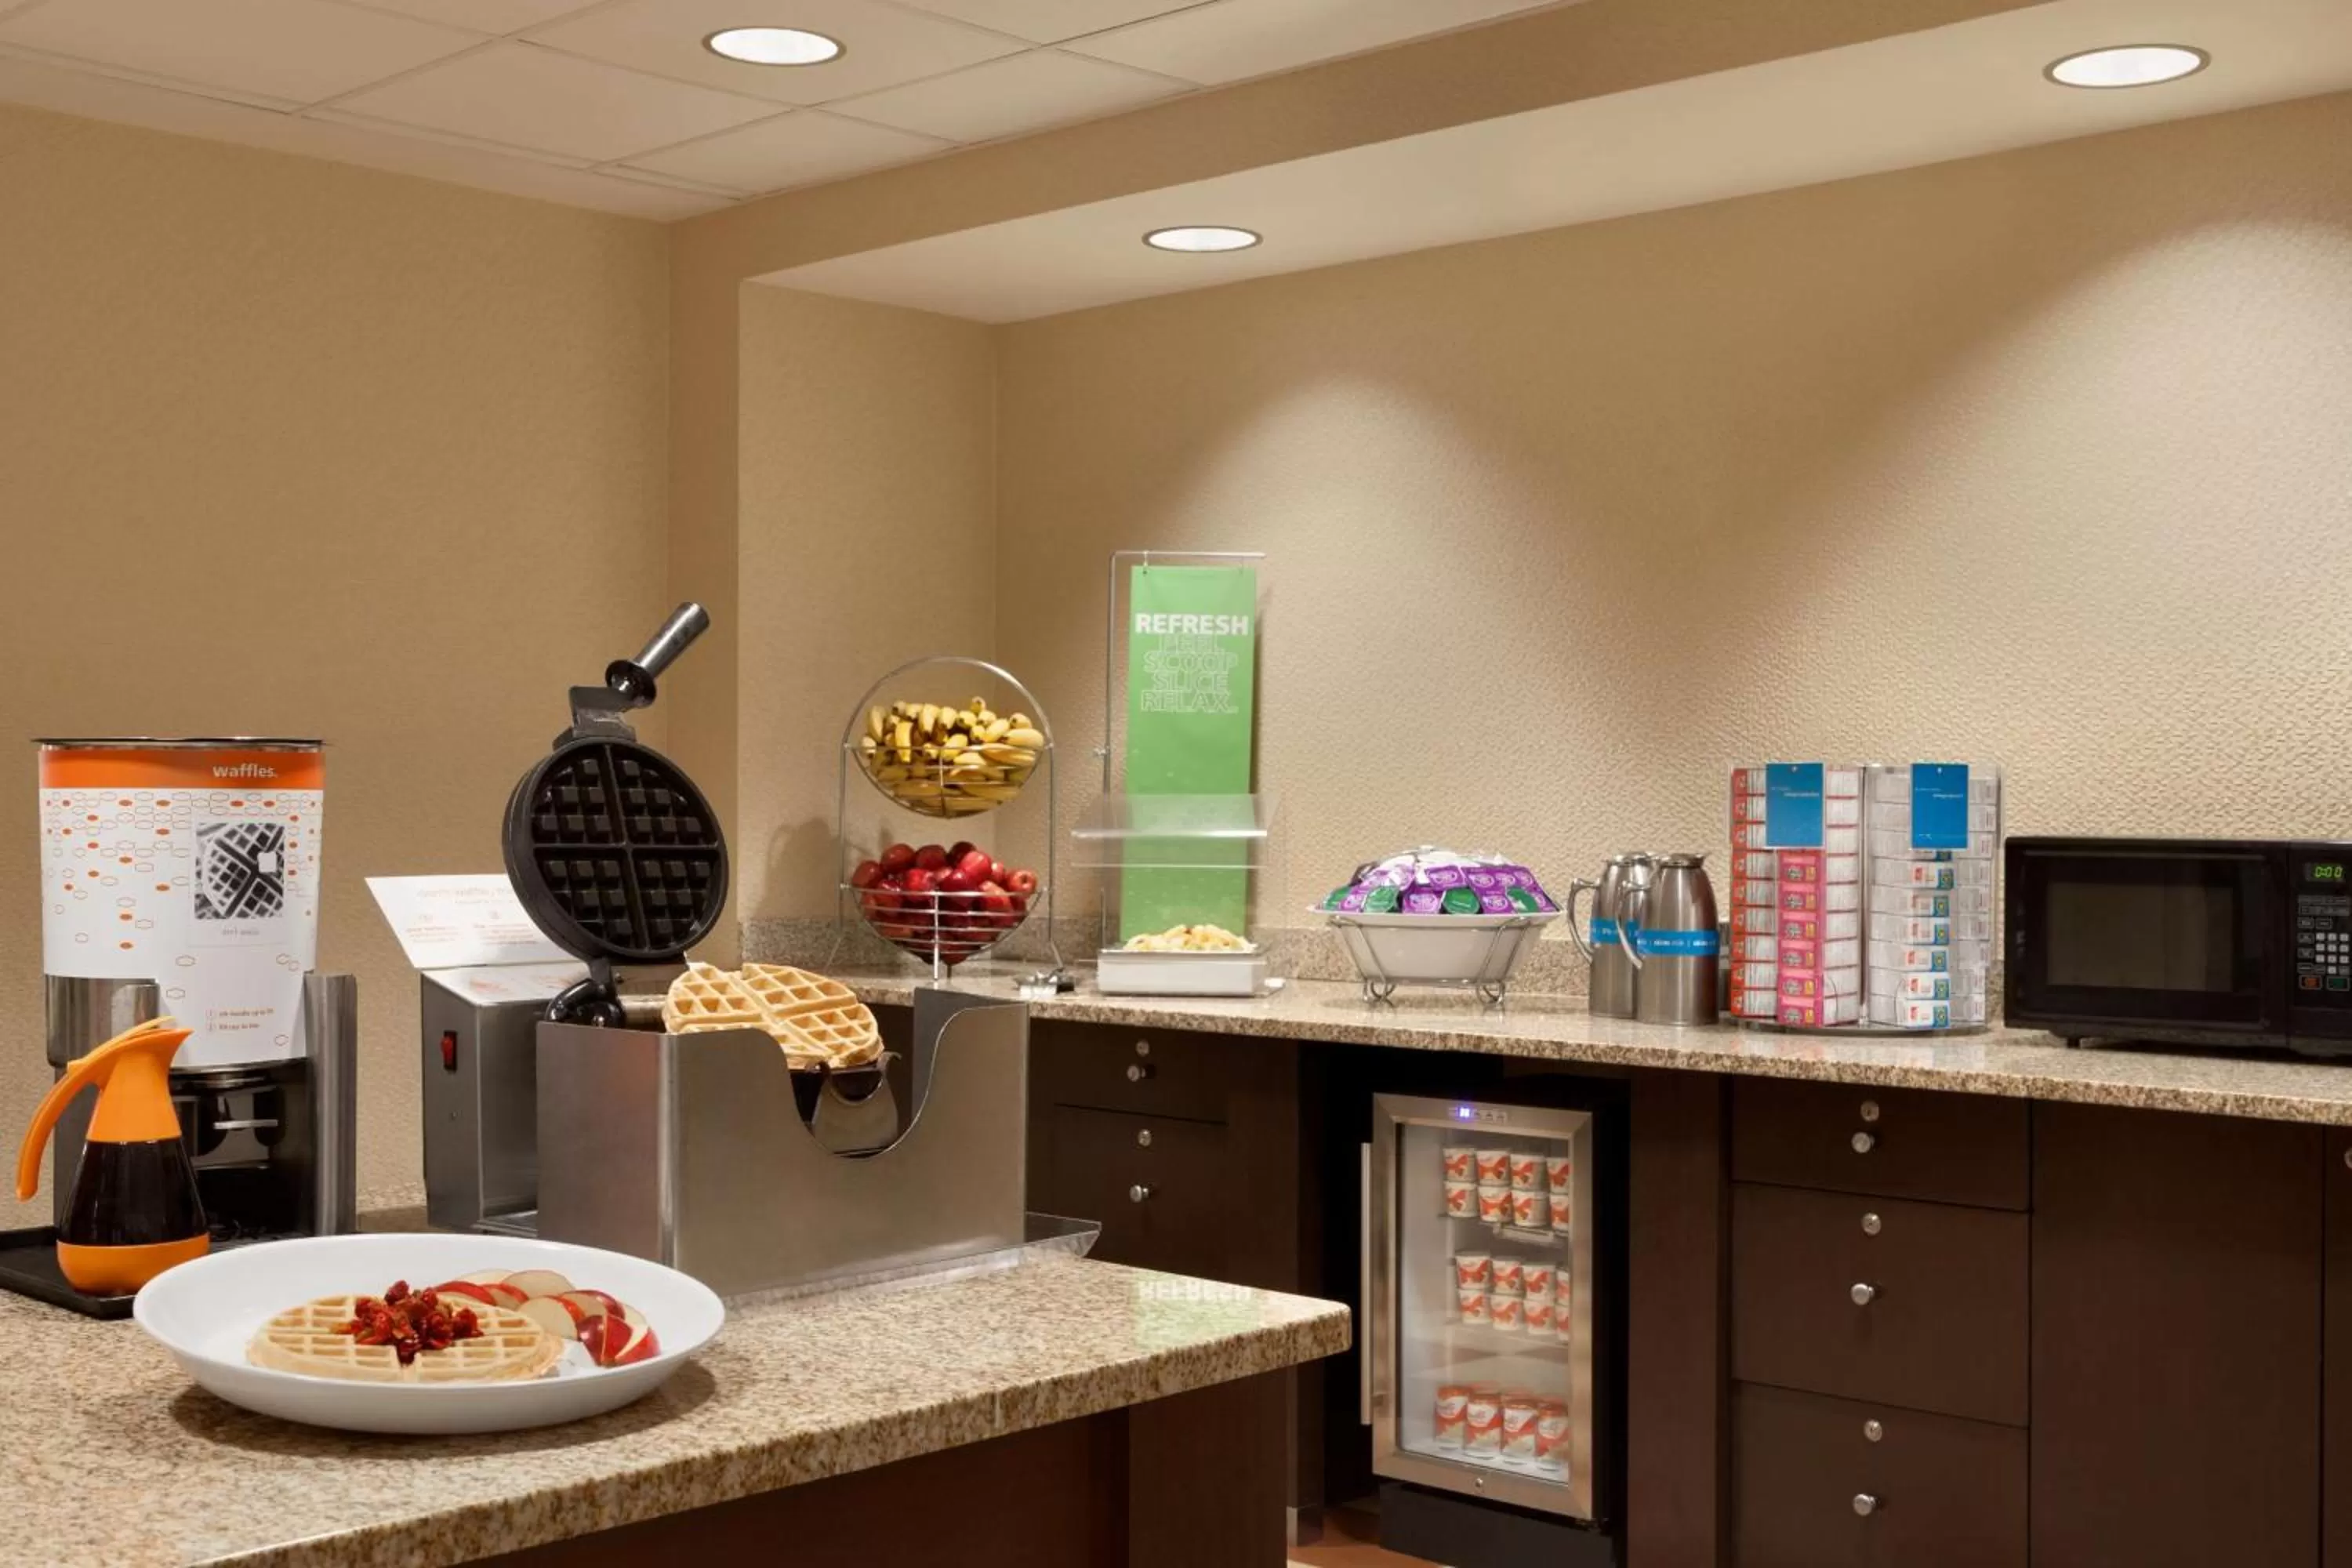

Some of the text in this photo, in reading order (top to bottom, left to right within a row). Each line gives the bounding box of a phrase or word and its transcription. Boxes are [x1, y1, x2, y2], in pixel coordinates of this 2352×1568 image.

[1135, 613, 1249, 635] REFRESH
[1143, 650, 1239, 673] SCOOP
[1152, 670, 1230, 692] SLICE
[212, 762, 278, 779] waffles.
